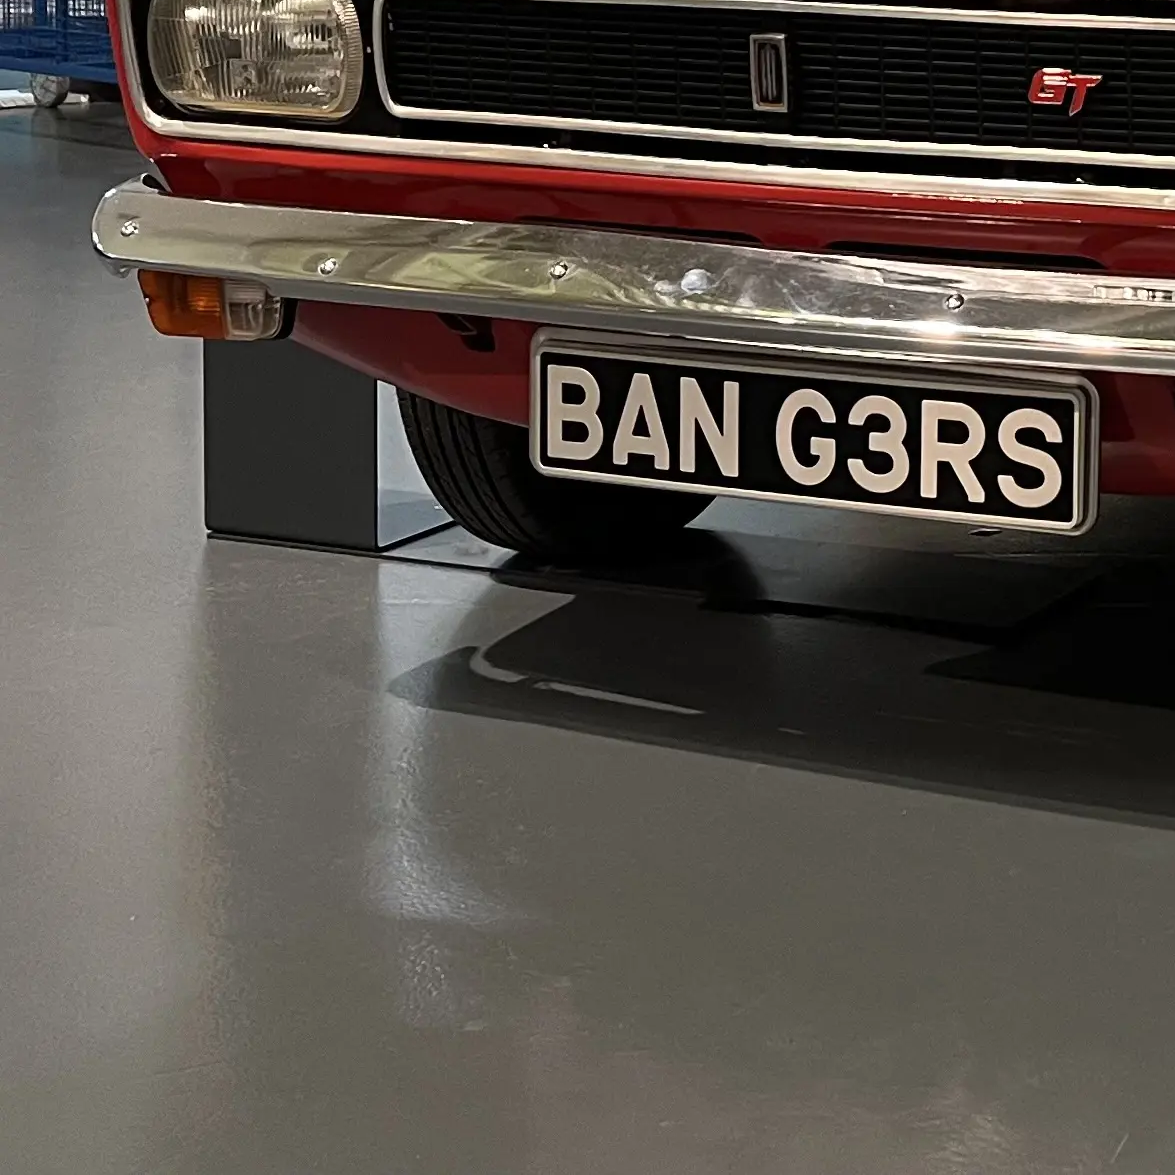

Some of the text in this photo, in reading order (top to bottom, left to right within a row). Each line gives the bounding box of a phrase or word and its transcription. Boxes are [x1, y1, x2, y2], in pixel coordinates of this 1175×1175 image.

[1027, 67, 1103, 117] GT
[546, 363, 1063, 508] BAN G3RS
